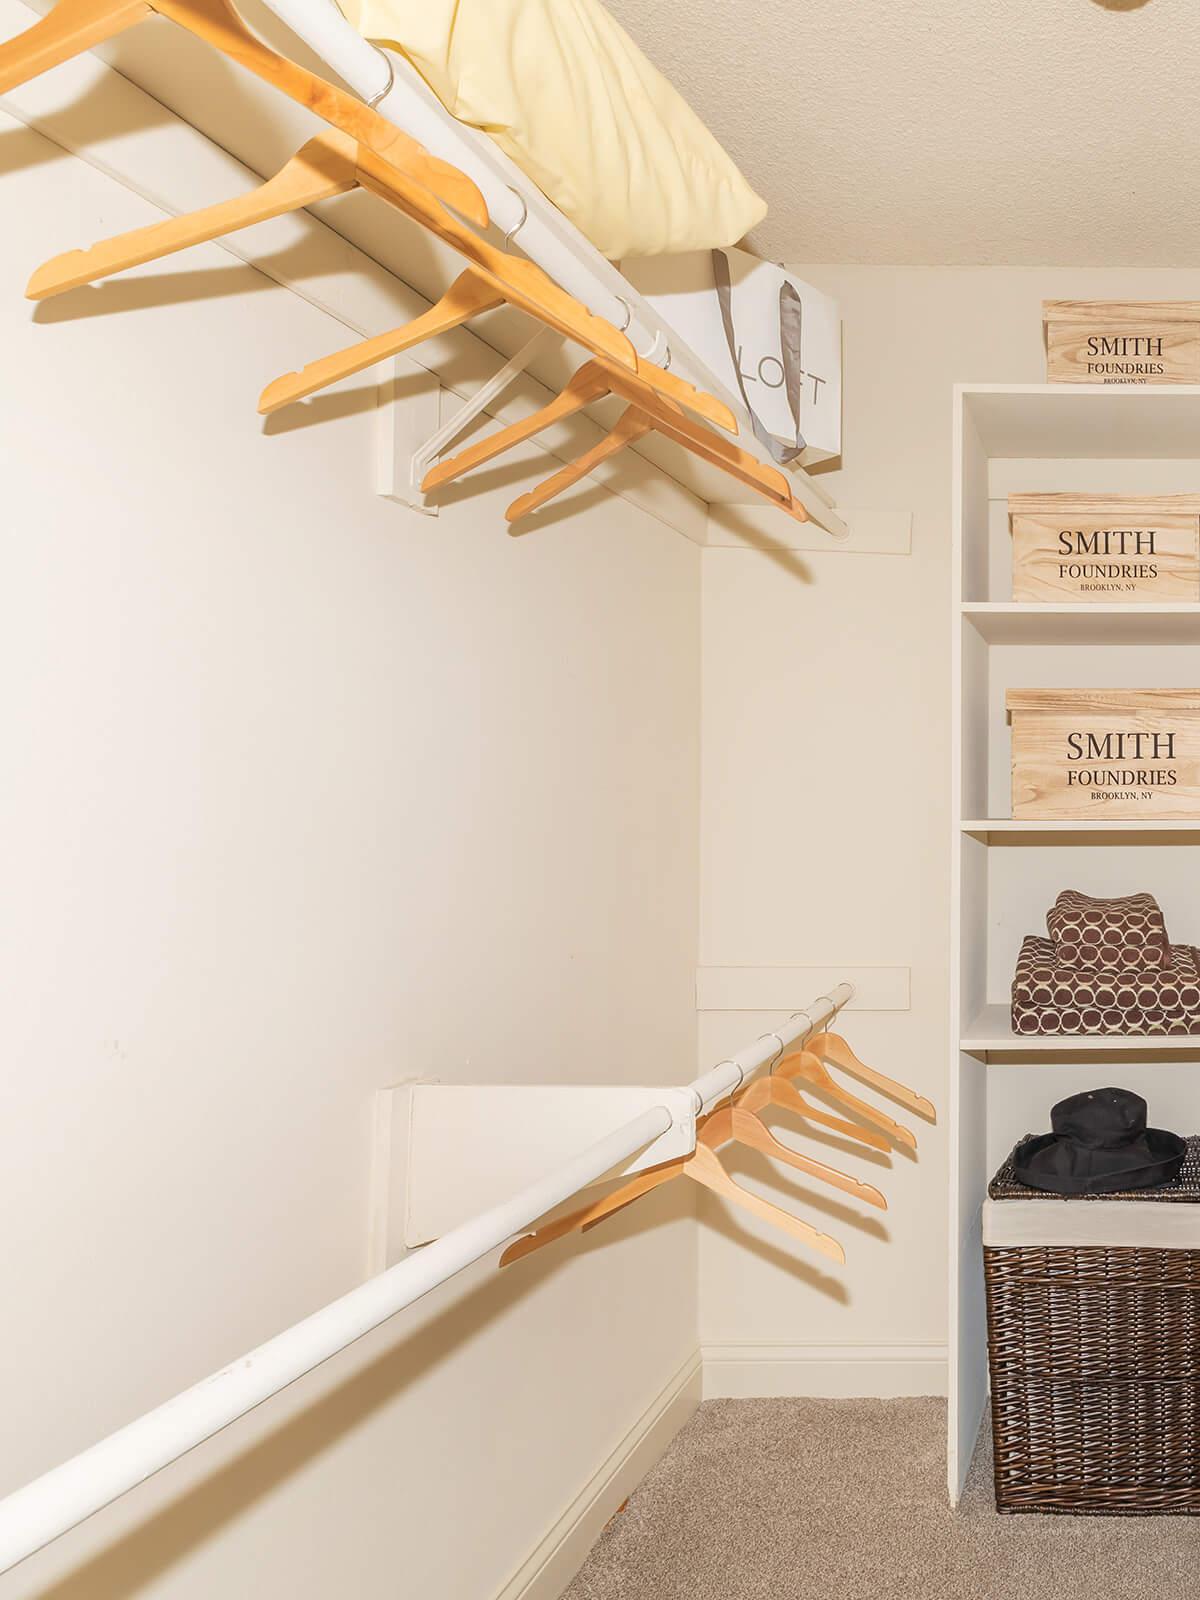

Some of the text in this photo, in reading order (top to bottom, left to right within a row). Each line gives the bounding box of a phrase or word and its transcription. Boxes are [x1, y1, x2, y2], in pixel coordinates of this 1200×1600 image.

[1087, 336, 1163, 356] SMITH
[1087, 363, 1164, 374] FOUNDRIES
[1058, 530, 1157, 555] SMITH
[1059, 564, 1158, 578] FOUNDRIES
[1126, 583, 1137, 591] NY
[1067, 732, 1177, 760] SMITH
[1067, 770, 1177, 786] FOUNDRIES
[1091, 791, 1153, 800] BROOKLYN, NY
